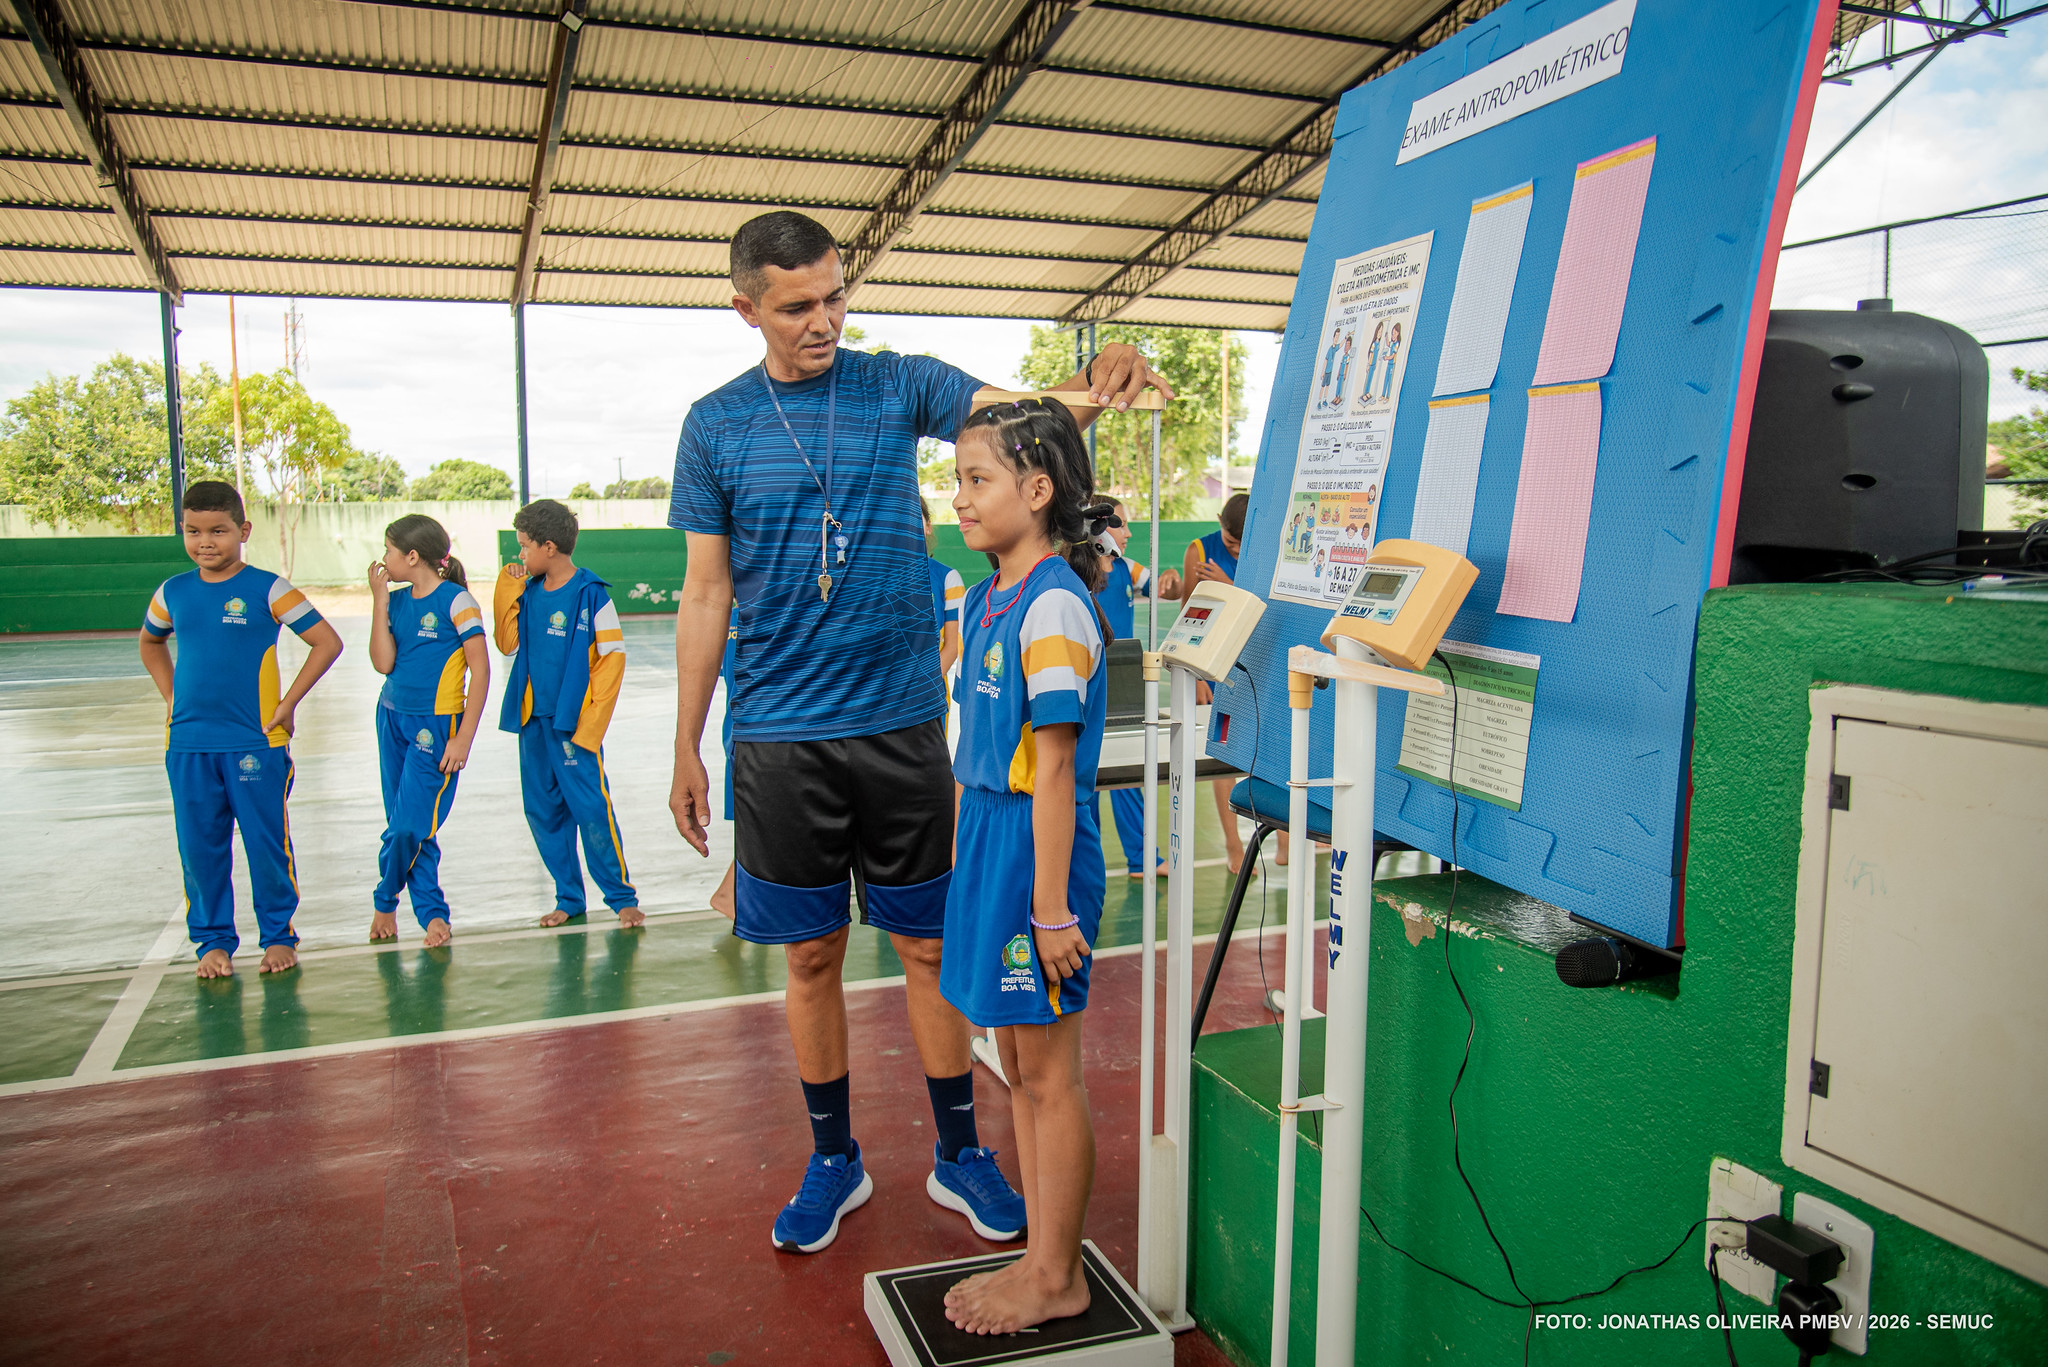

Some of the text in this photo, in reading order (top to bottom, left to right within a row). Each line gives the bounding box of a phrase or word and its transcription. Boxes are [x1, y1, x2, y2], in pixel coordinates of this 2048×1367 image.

[1401, 26, 1630, 149] EXAME ANTROPOMÉTRICO
[1352, 261, 1376, 277] MEDIDAS
[1337, 280, 1355, 294] COLETA
[1403, 266, 1409, 278] E
[1408, 263, 1421, 276] IMC
[1333, 567, 1341, 580] 16
[1341, 568, 1348, 581] A
[1347, 568, 1358, 582] 27
[1329, 583, 1337, 592] DE
[1337, 584, 1352, 595] MAR
[1343, 605, 1374, 617] WELMY
[1477, 697, 1523, 713] MAGREZA ACENTUADA
[1487, 716, 1508, 726] MAGREZA
[1481, 748, 1505, 759] SOBREPESO
[1479, 764, 1502, 775] OBESIDADE
[1470, 777, 1493, 789] OBESIDADE
[1493, 785, 1508, 794] GRAVE
[1001, 976, 1036, 985] PREFEITUR
[1001, 984, 1018, 992] BOA
